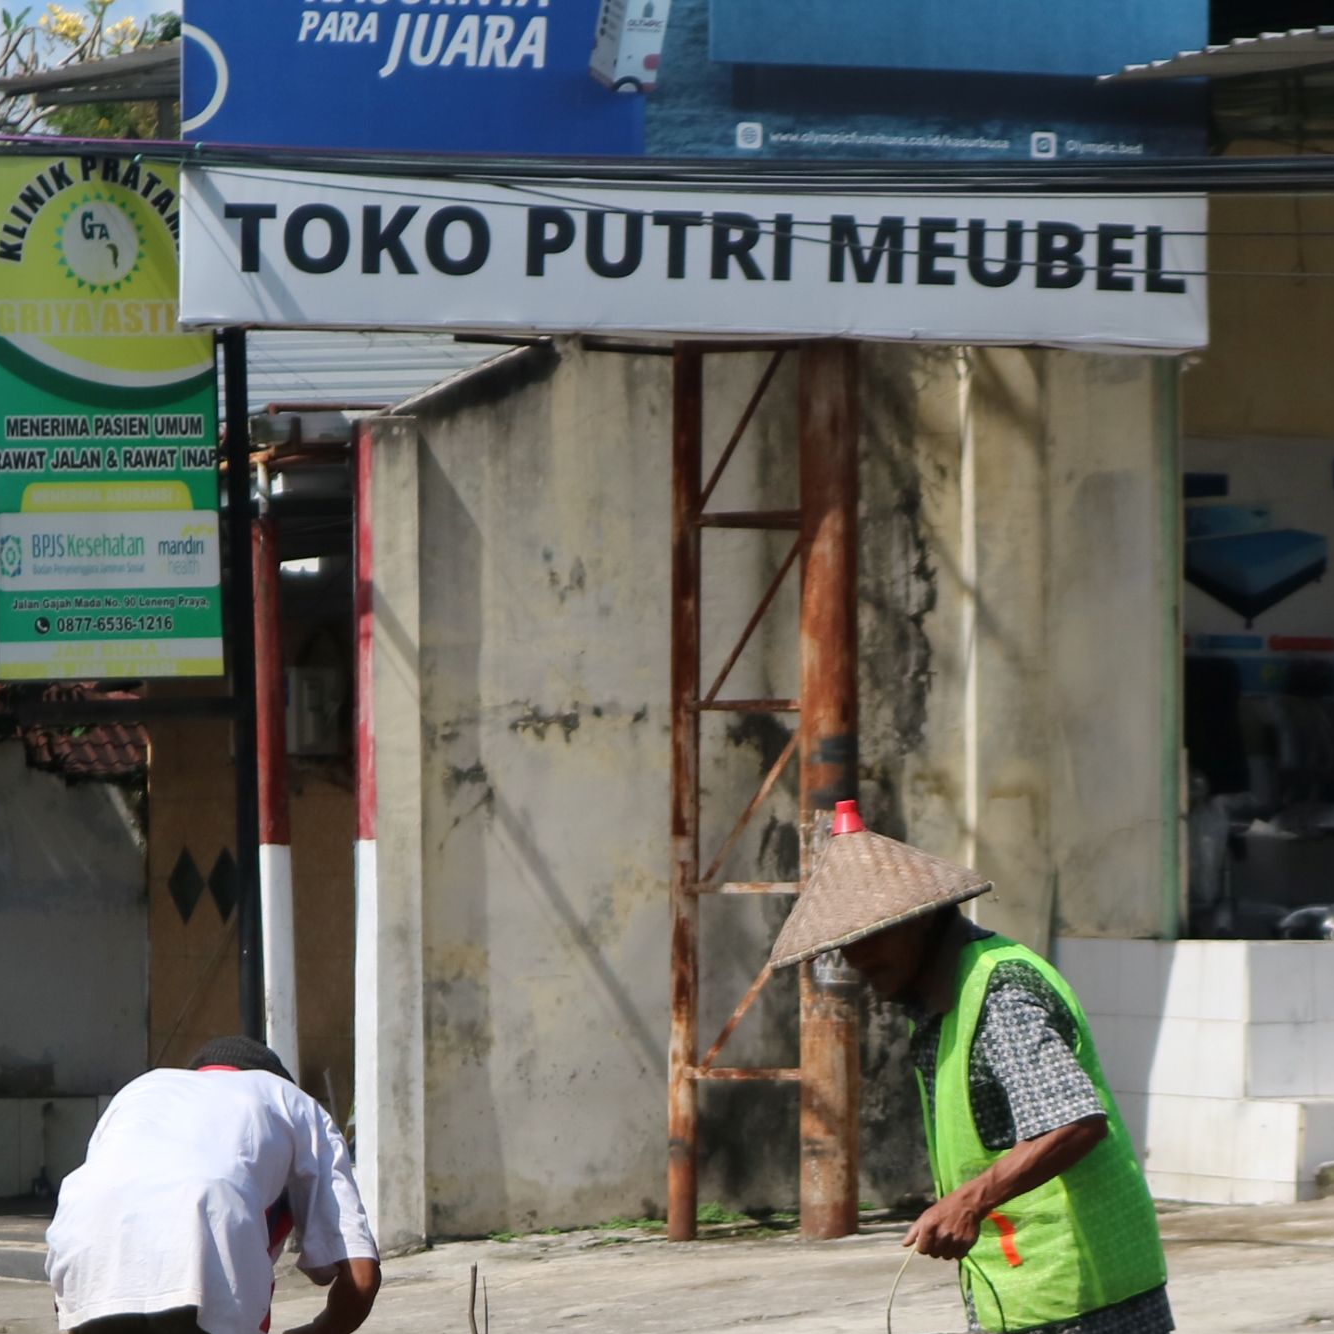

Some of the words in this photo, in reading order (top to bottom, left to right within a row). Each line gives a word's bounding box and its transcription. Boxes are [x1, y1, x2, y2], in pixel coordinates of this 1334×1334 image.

[298, 11, 378, 42] PARA
[378, 13, 547, 78] JUARA
[769, 131, 1010, 150] www.olympicfurniture.co.id/kasurbusa
[1065, 139, 1144, 155] Olympic.bed
[224, 203, 490, 276] TOKO
[526, 207, 793, 281] PUTRI
[828, 214, 1187, 294] MEUBEL
[6, 417, 90, 437] MENERIMA
[95, 416, 148, 436] PASIEN
[155, 416, 203, 436] UMUM
[51, 450, 101, 468] JALAN
[107, 449, 118, 468] &
[124, 449, 176, 468] RAWAT
[182, 448, 217, 467] INAP
[32, 535, 65, 558] BPJS
[67, 533, 144, 557] Kesehatan
[158, 535, 204, 555] mandiri
[12, 599, 39, 610] Jalan
[43, 598, 71, 612] Gajah
[75, 598, 101, 609] Mada
[105, 597, 120, 608] No.
[57, 616, 173, 633] 0877-6536-1216
